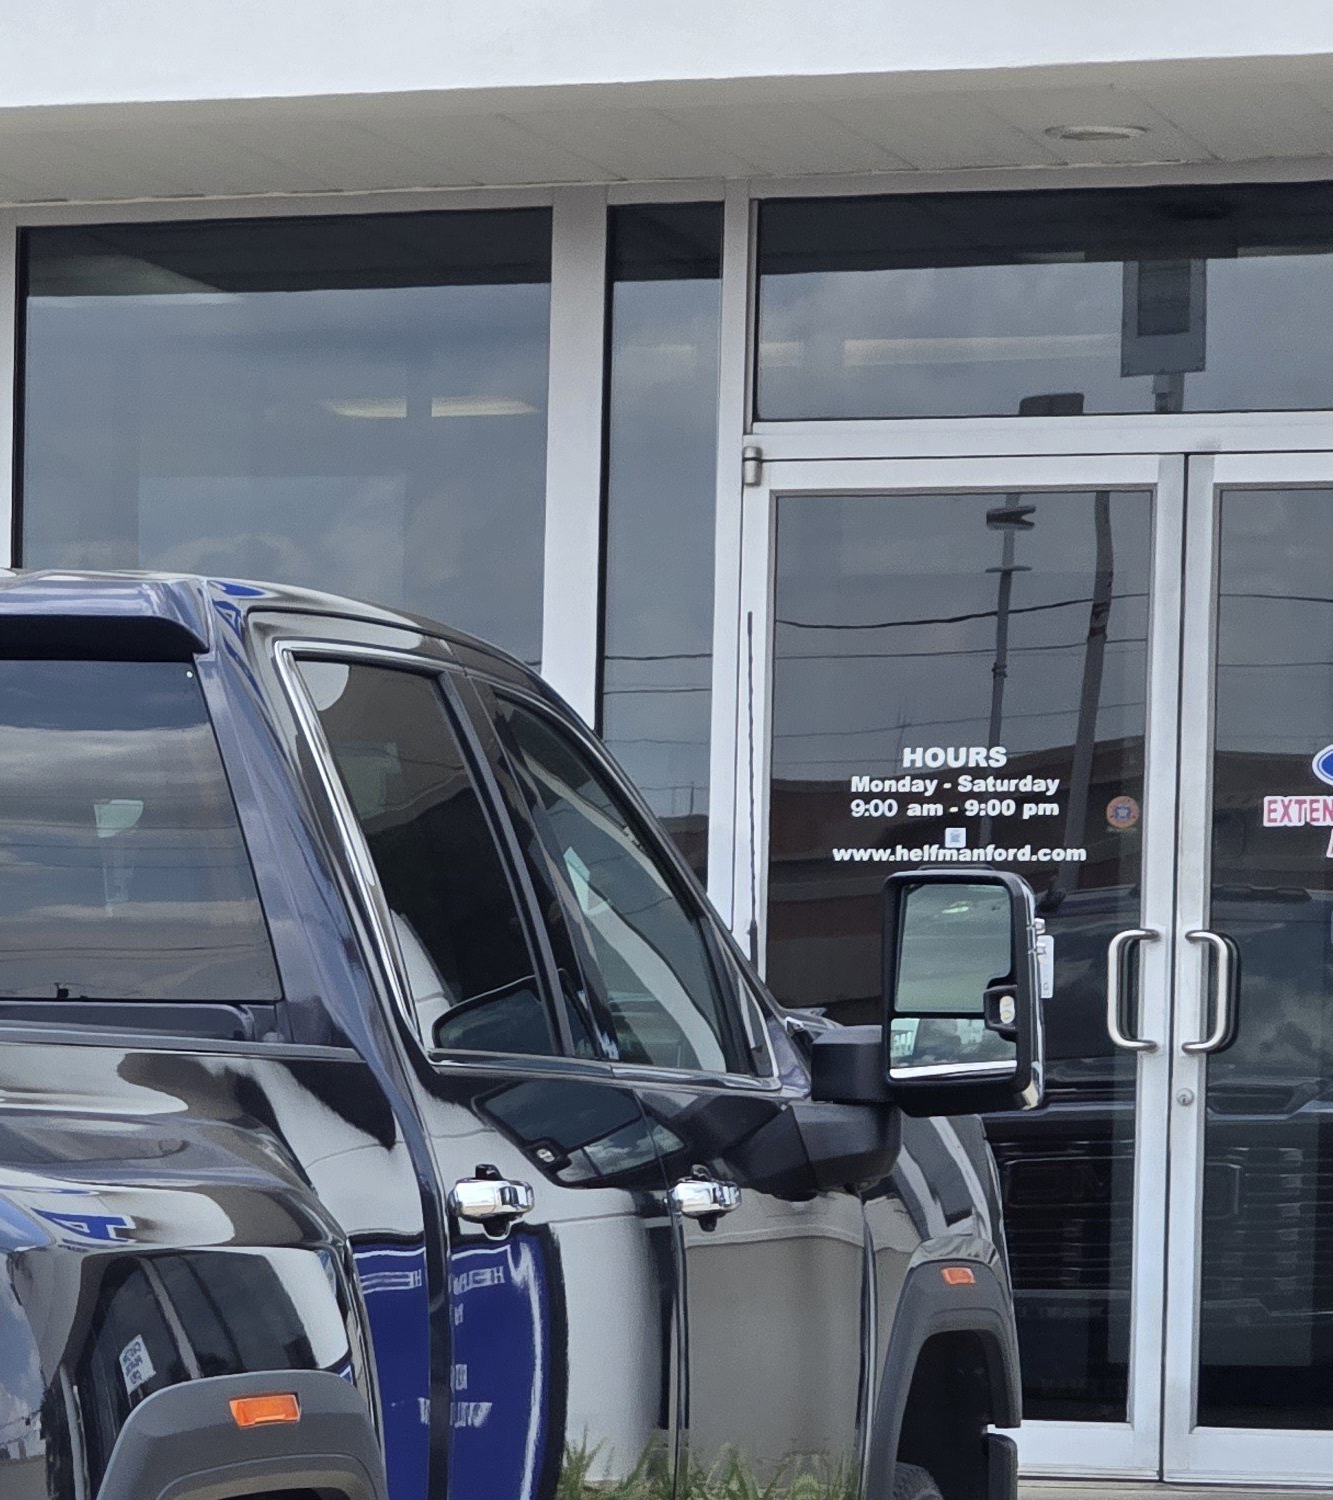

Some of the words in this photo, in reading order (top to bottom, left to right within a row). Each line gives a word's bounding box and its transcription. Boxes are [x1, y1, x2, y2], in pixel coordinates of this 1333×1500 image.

[902, 746, 1008, 768] HOURS
[851, 775, 938, 796] Monday
[957, 775, 1060, 796] Saturday
[850, 798, 899, 817] 9:00
[906, 802, 944, 817] am
[949, 805, 959, 813] -
[964, 798, 1016, 817] 9:00
[1022, 802, 1060, 820] pm
[832, 845, 1087, 862] www.helfmanford.com
